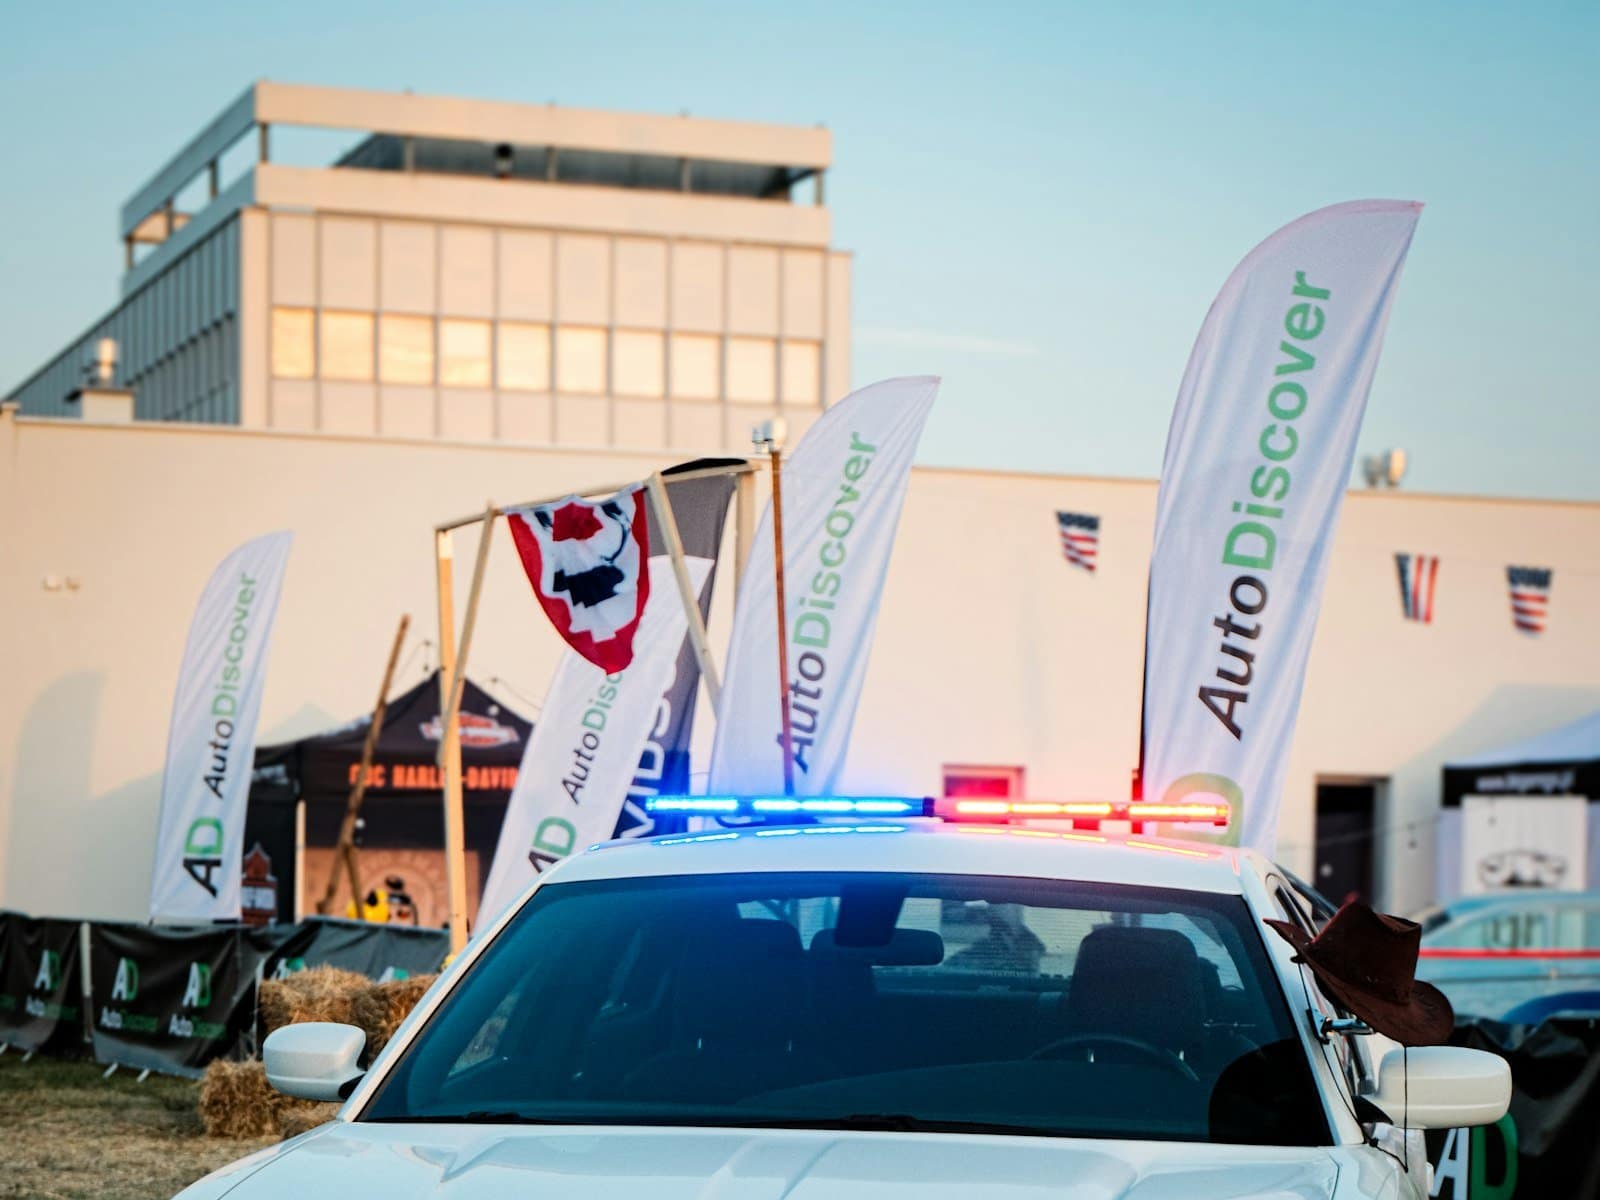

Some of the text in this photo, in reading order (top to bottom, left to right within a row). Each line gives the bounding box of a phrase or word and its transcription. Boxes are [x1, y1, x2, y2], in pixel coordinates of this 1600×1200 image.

[1197, 270, 1332, 741] AutoDiscover
[775, 431, 877, 774] AutoDiscover
[183, 573, 258, 898] AD AutoDiscover
[35, 950, 61, 990] AD
[112, 957, 139, 1001] AD
[182, 962, 211, 1007] AD
